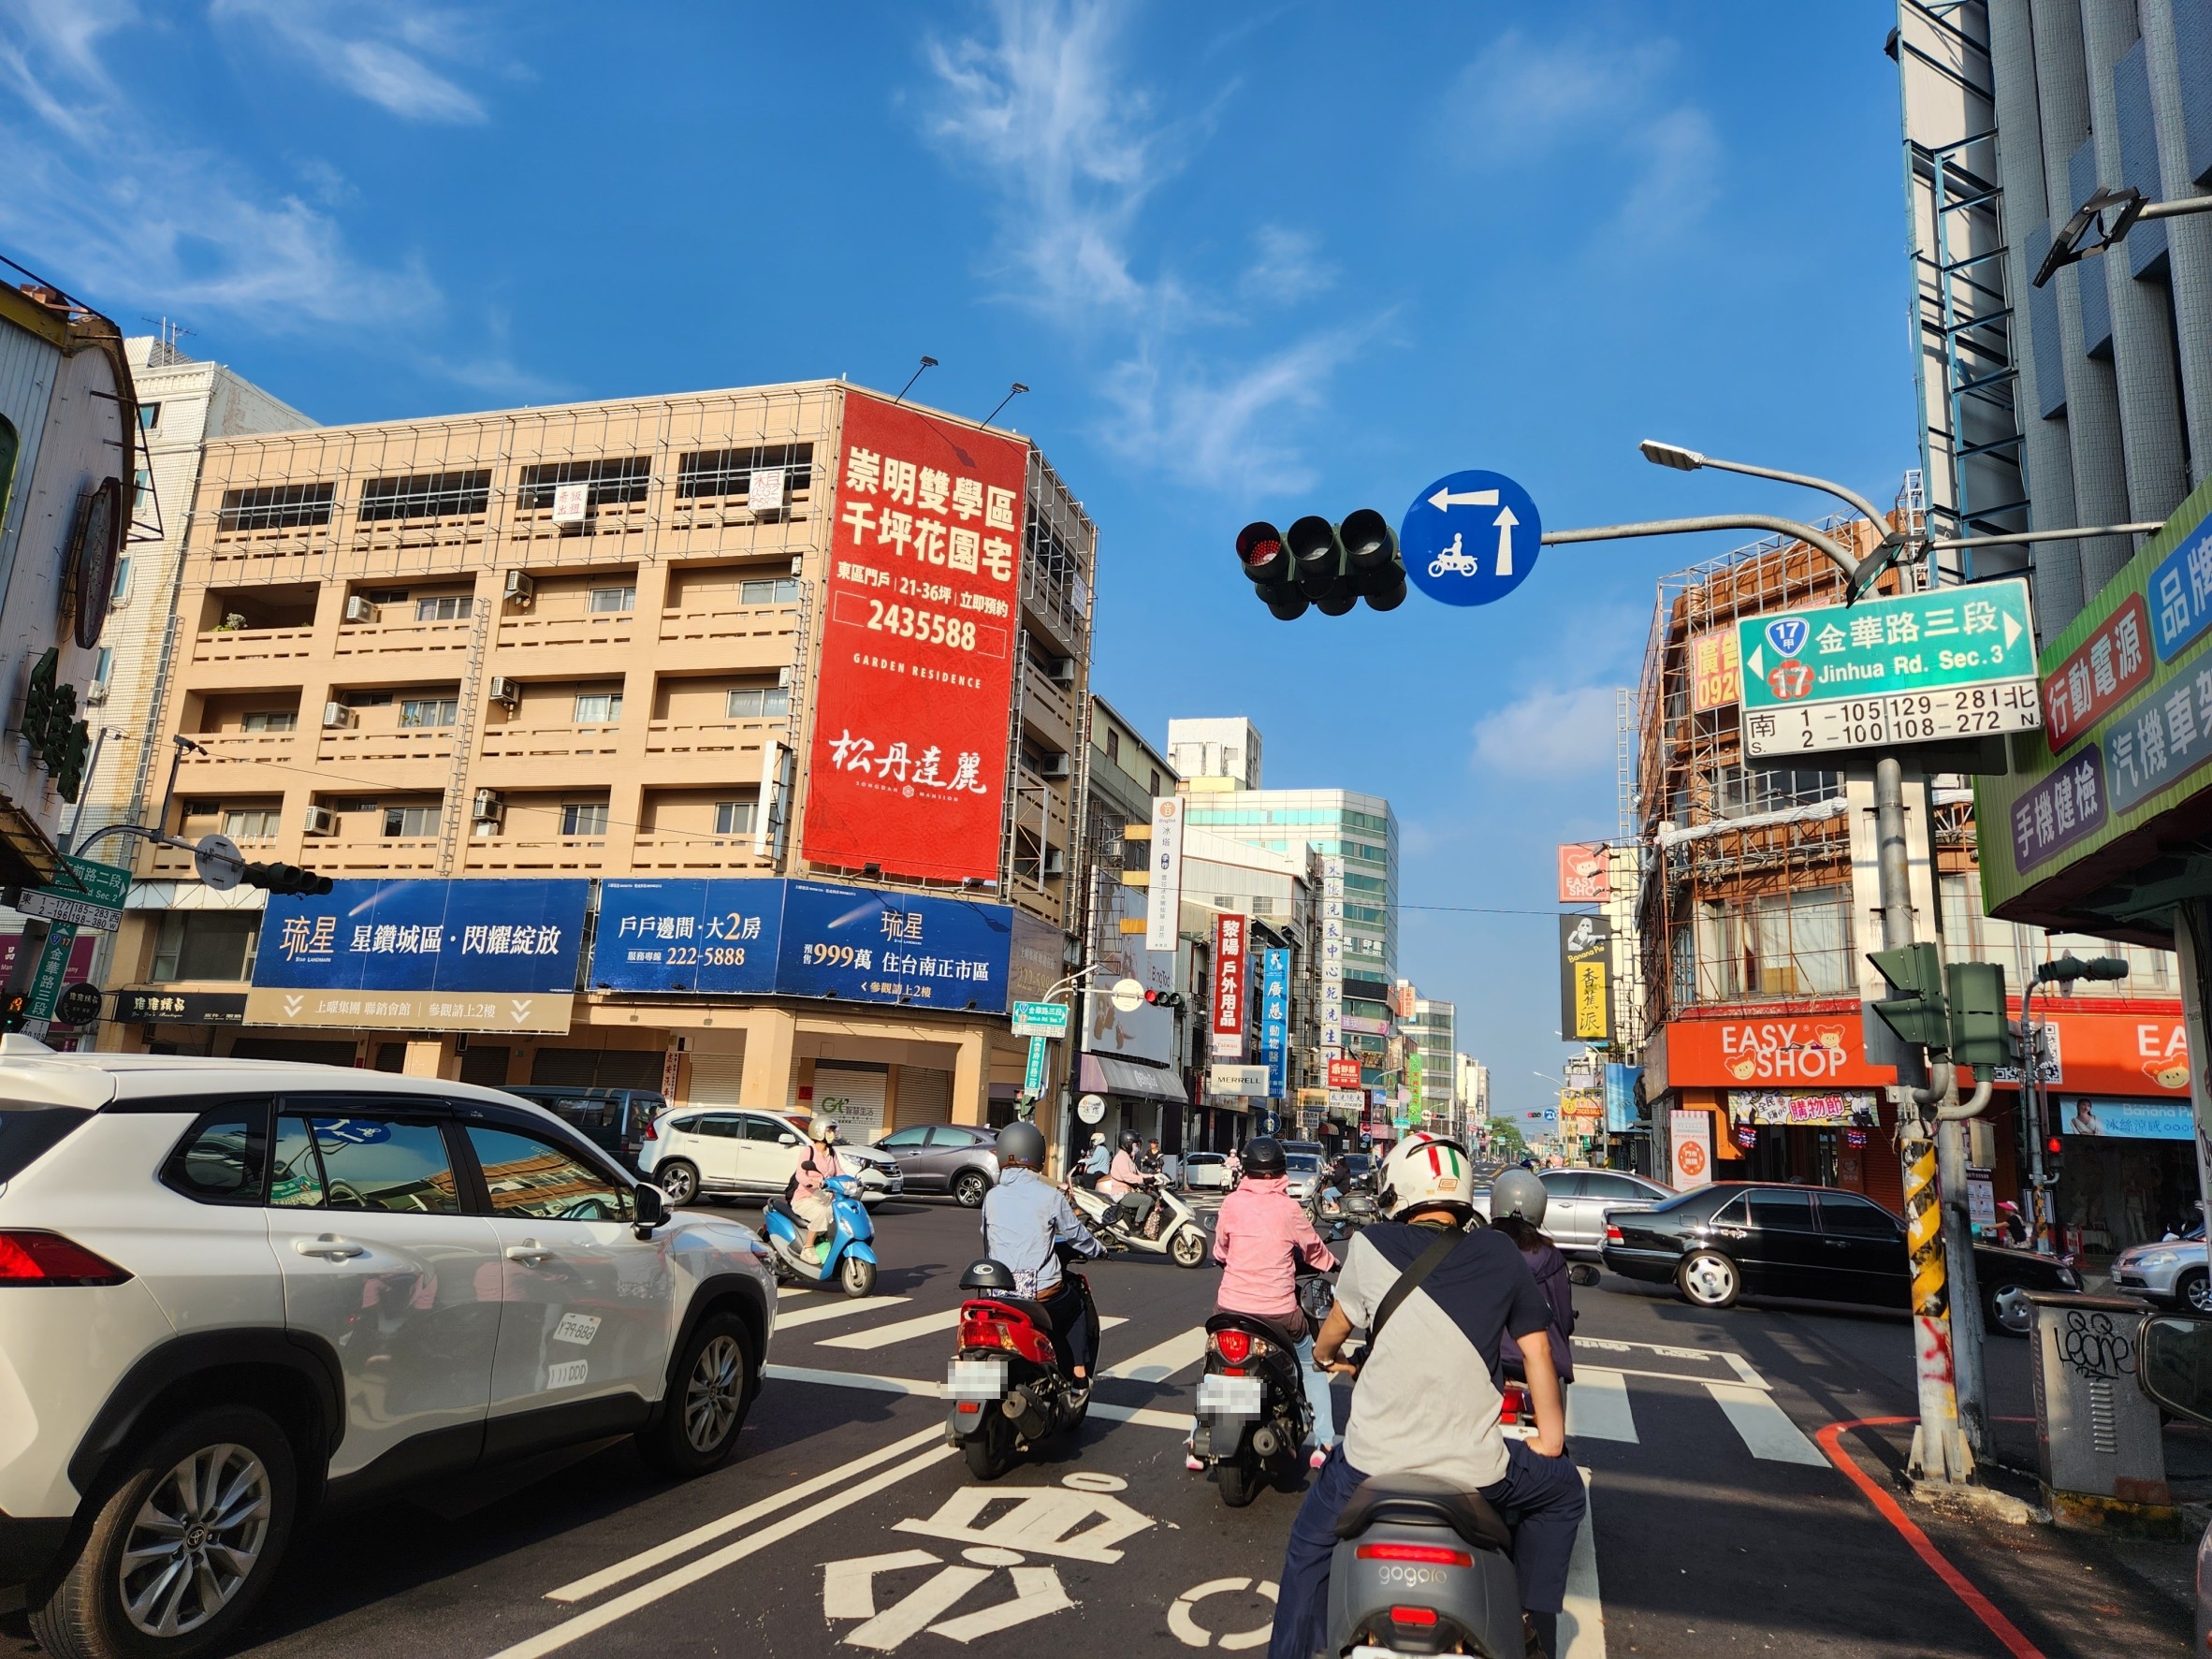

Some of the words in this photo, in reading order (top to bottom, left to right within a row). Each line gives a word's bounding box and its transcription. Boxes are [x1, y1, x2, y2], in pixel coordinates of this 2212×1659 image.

[846, 446, 1017, 532] 崇明雙學區
[842, 502, 1013, 582] 千坪花園宅
[837, 561, 891, 588] 東區門戶
[899, 576, 953, 604] 21-36坪
[959, 590, 1009, 618] 立即預約
[866, 599, 977, 651] 2435588
[1775, 621, 1797, 640] 17
[1815, 600, 1999, 655] 金華路三段
[853, 652, 906, 674] GARDEN
[911, 663, 982, 690] RESIDENCE
[1818, 661, 1885, 684] Jinhua
[1894, 654, 1928, 676] Rd.
[1939, 647, 1988, 671] Sec.
[1990, 644, 2003, 663] 3
[2049, 607, 2142, 739] 行動電源
[1749, 714, 1776, 739] 南
[2004, 685, 2036, 710] 北
[828, 729, 987, 794] 松丹達麗
[855, 780, 898, 793] SONGDAN
[919, 791, 959, 802] MANSION
[2016, 759, 2098, 858] 手機健檢
[1565, 877, 1596, 888] EASY
[22, 893, 34, 906] 東
[74, 903, 109, 919] 185-283
[109, 911, 120, 924] 西
[71, 912, 107, 929] 198-380
[880, 911, 924, 942] 琉星
[279, 915, 337, 962] 琉星
[1221, 920, 1240, 955] 黎陽
[1567, 947, 1594, 964] Banana
[1594, 945, 1605, 955] Pie
[627, 951, 662, 962] 服務專線
[666, 947, 746, 967] 222-5888
[813, 942, 872, 971] 999萬
[881, 951, 990, 982] 住台南正市區
[32, 947, 64, 1016] 金華路三段
[1219, 960, 1238, 1027] 戶外用品
[1579, 967, 1603, 1032] 香蕉派
[315, 999, 361, 1016] 上曜集團
[364, 1000, 412, 1017] 聯銷會館
[428, 1001, 497, 1019] 參觀請上2樓
[1722, 1024, 1797, 1054] EASY
[1217, 1076, 1261, 1084] MERRELL
[1756, 1047, 1847, 1078] SHOP
[1788, 1094, 1844, 1122] 購物節
[2105, 1117, 2161, 1133] 冰絲涼感
[2123, 1103, 2176, 1117] Banana
